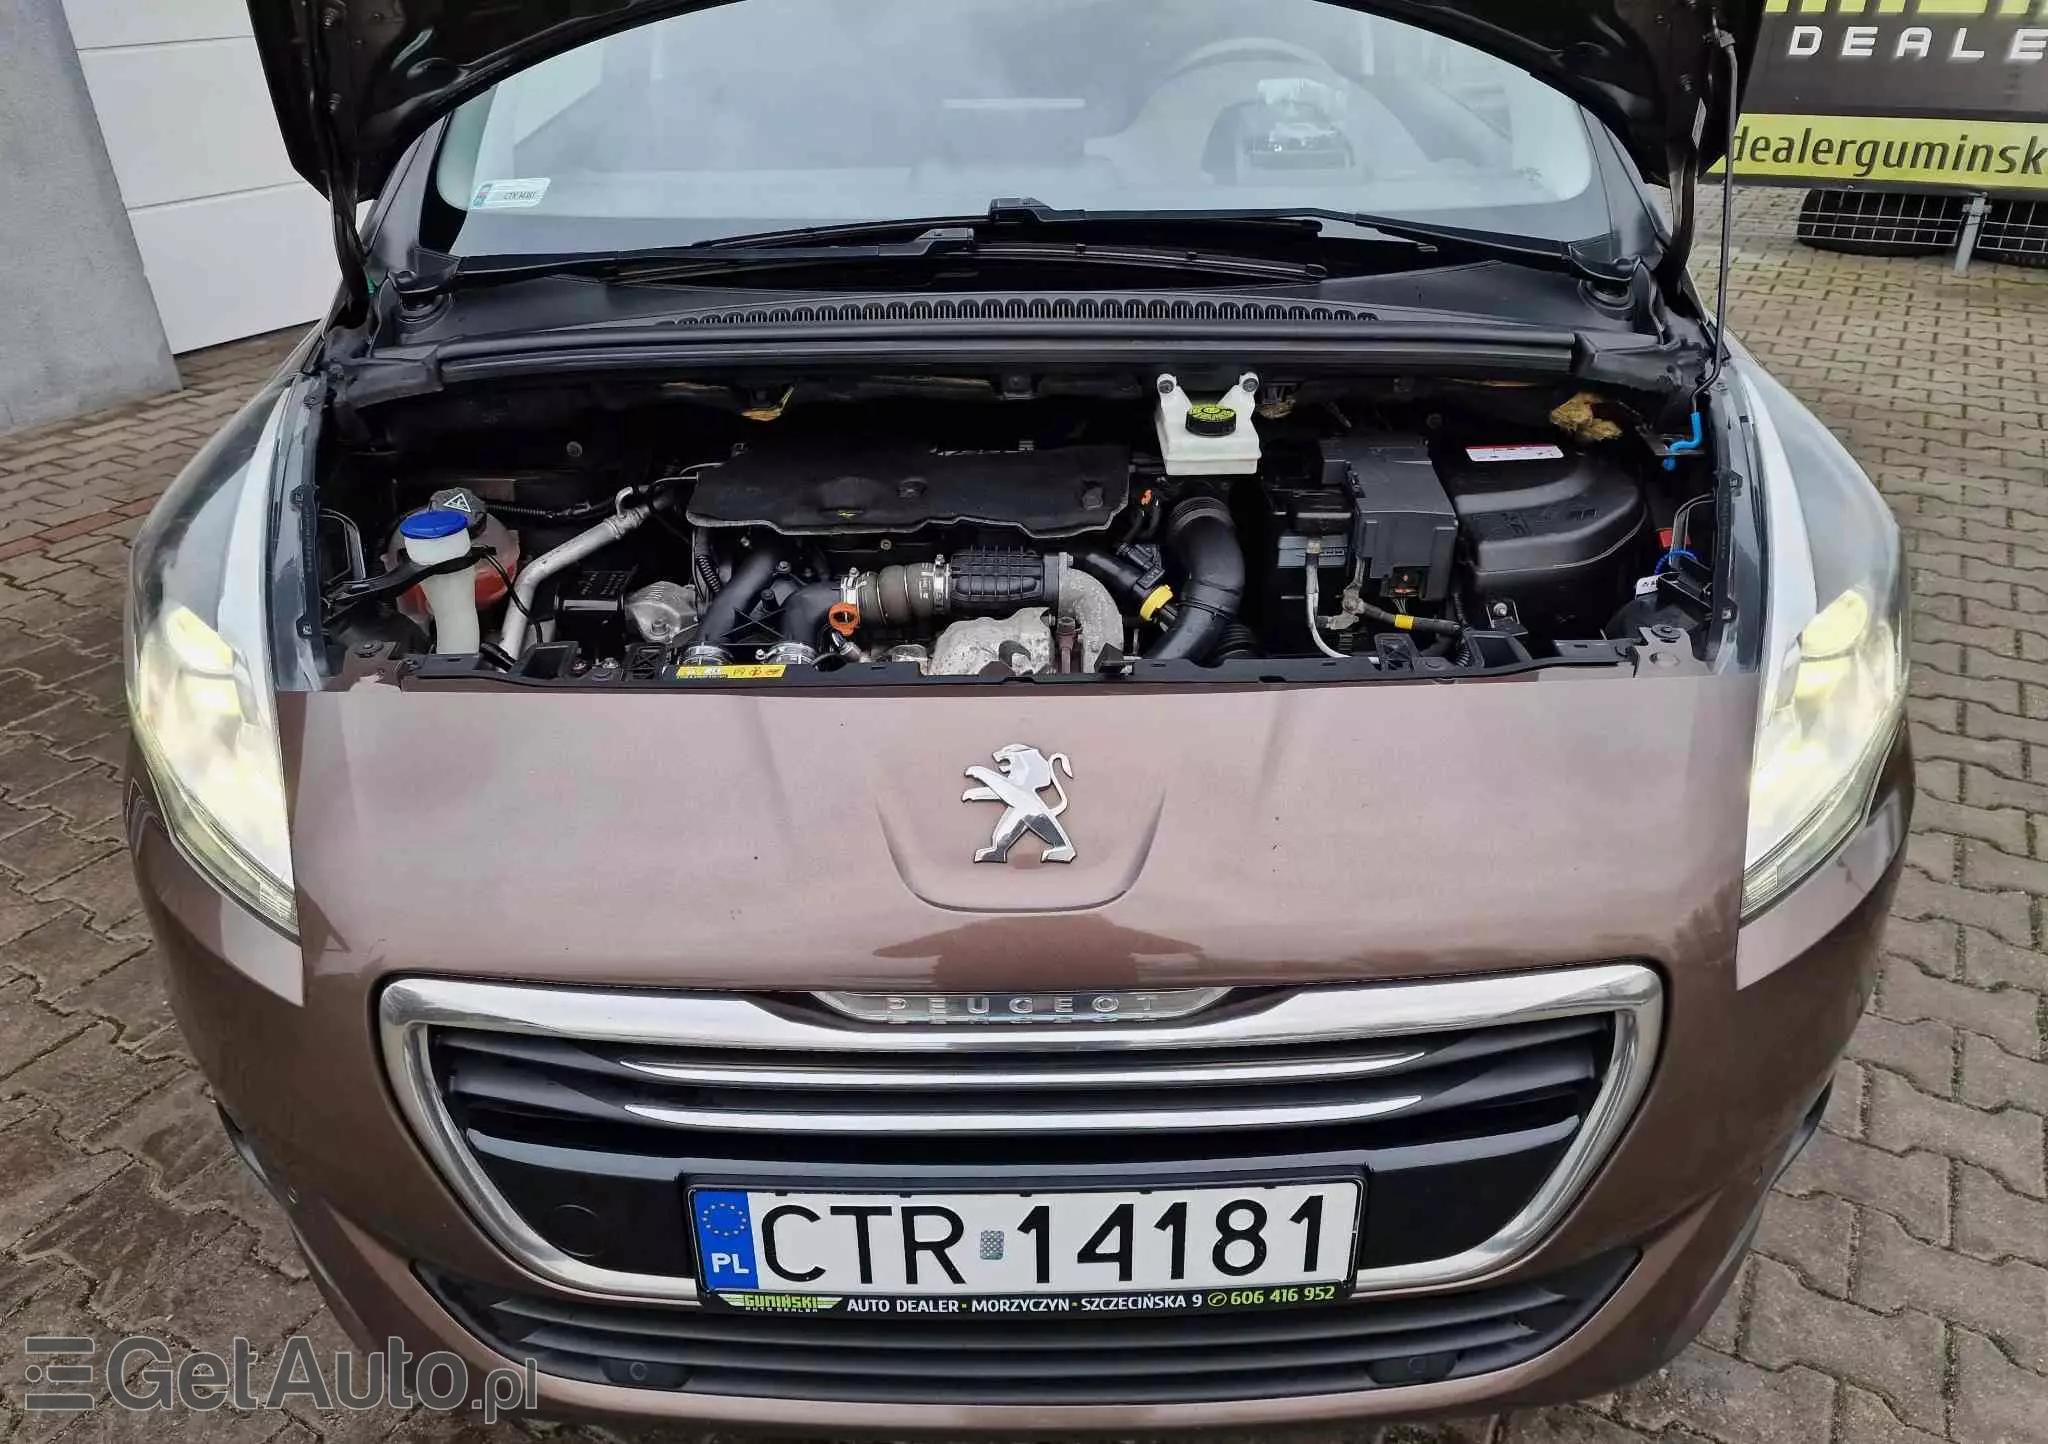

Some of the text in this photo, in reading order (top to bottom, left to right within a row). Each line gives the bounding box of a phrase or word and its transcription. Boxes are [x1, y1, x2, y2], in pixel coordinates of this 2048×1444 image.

[886, 996, 1158, 1015] PEUGEOT
[761, 1194, 1324, 1285] CTR 14181
[711, 1252, 749, 1274] PL
[847, 1286, 1336, 1312] AUTO DEALER MORZYCZYN SZCZECIŃSKA 9 606 416 952
